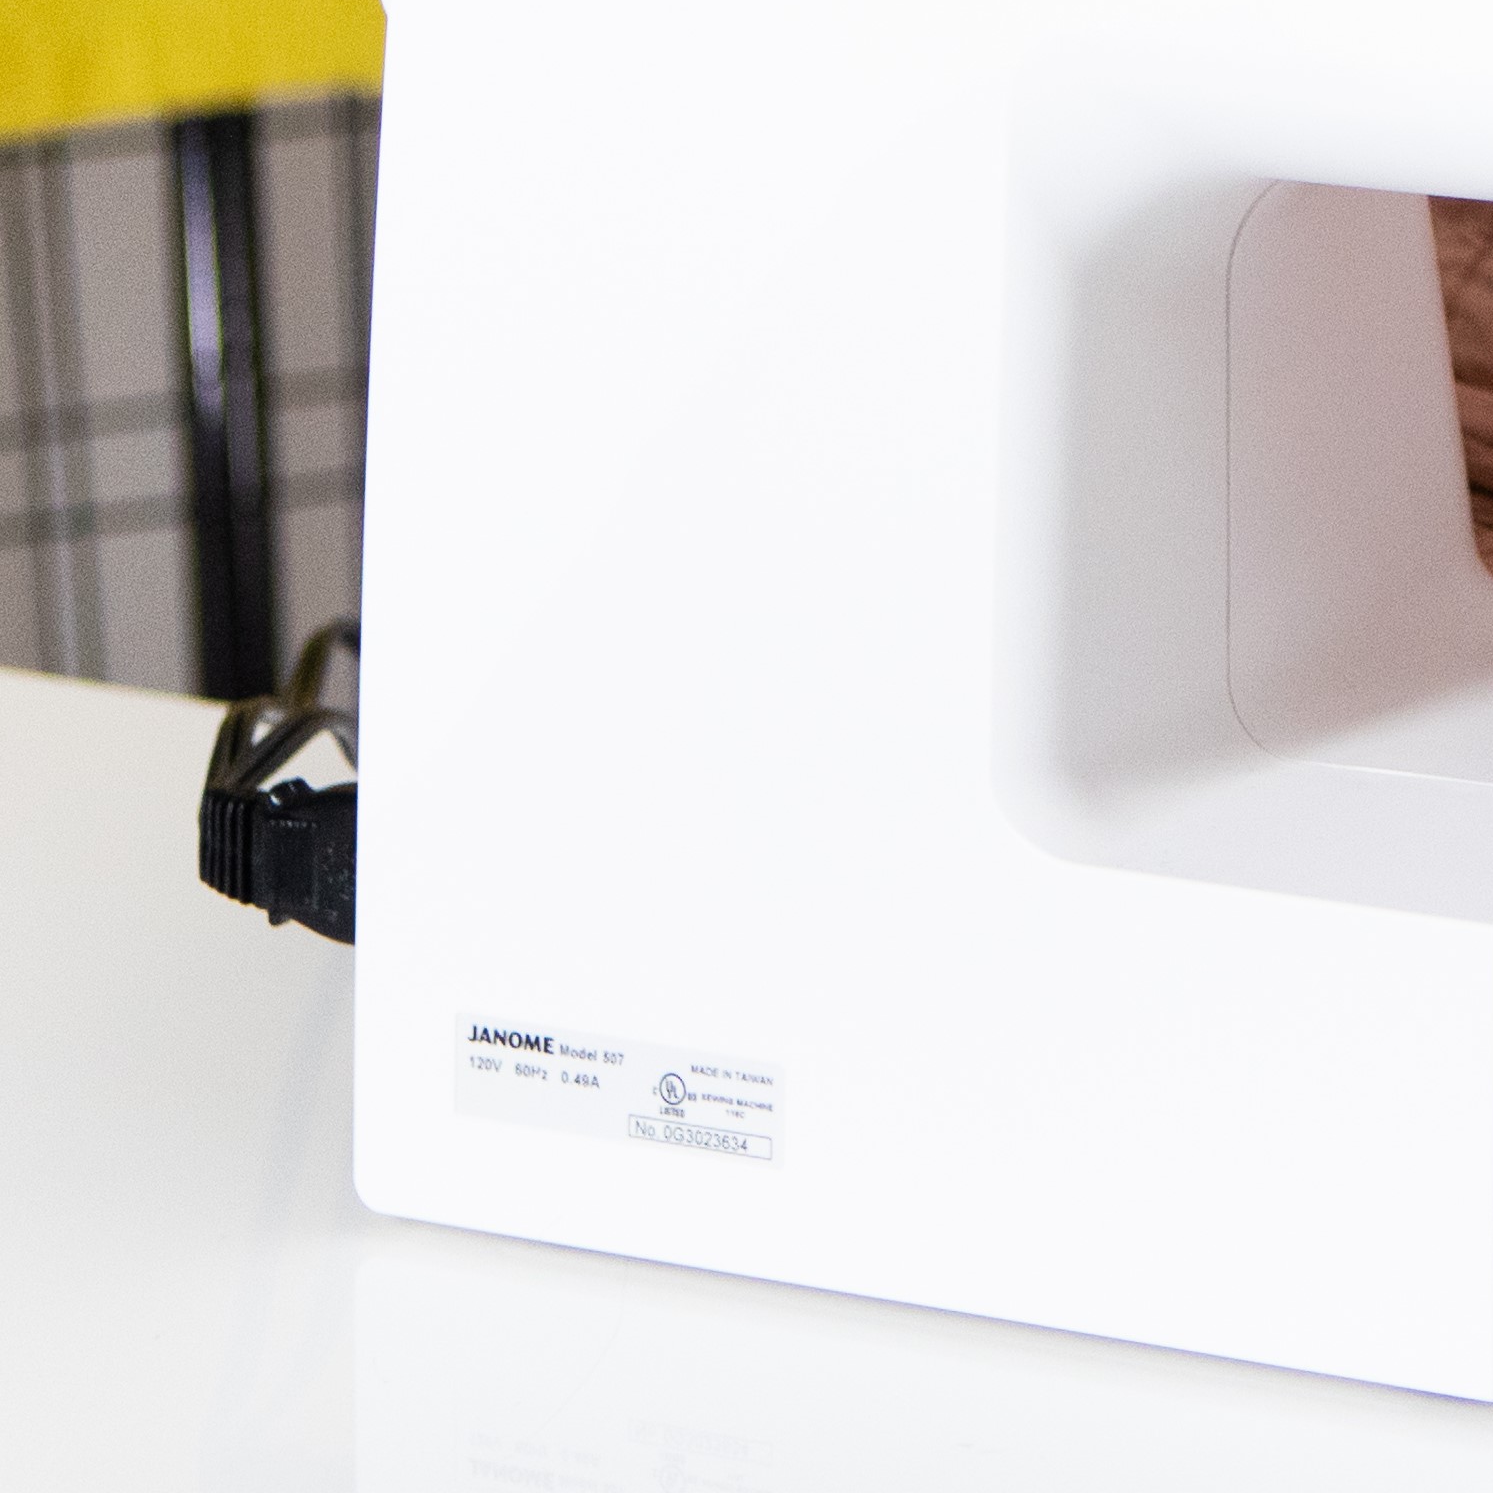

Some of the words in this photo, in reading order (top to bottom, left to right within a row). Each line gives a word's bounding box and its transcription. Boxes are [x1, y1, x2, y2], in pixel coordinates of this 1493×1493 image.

[468, 1025, 555, 1055] JANOME
[559, 1043, 598, 1062] Model
[469, 1055, 502, 1073] 120V
[691, 1065, 718, 1078] MADE
[736, 1071, 774, 1086] TAIWAN
